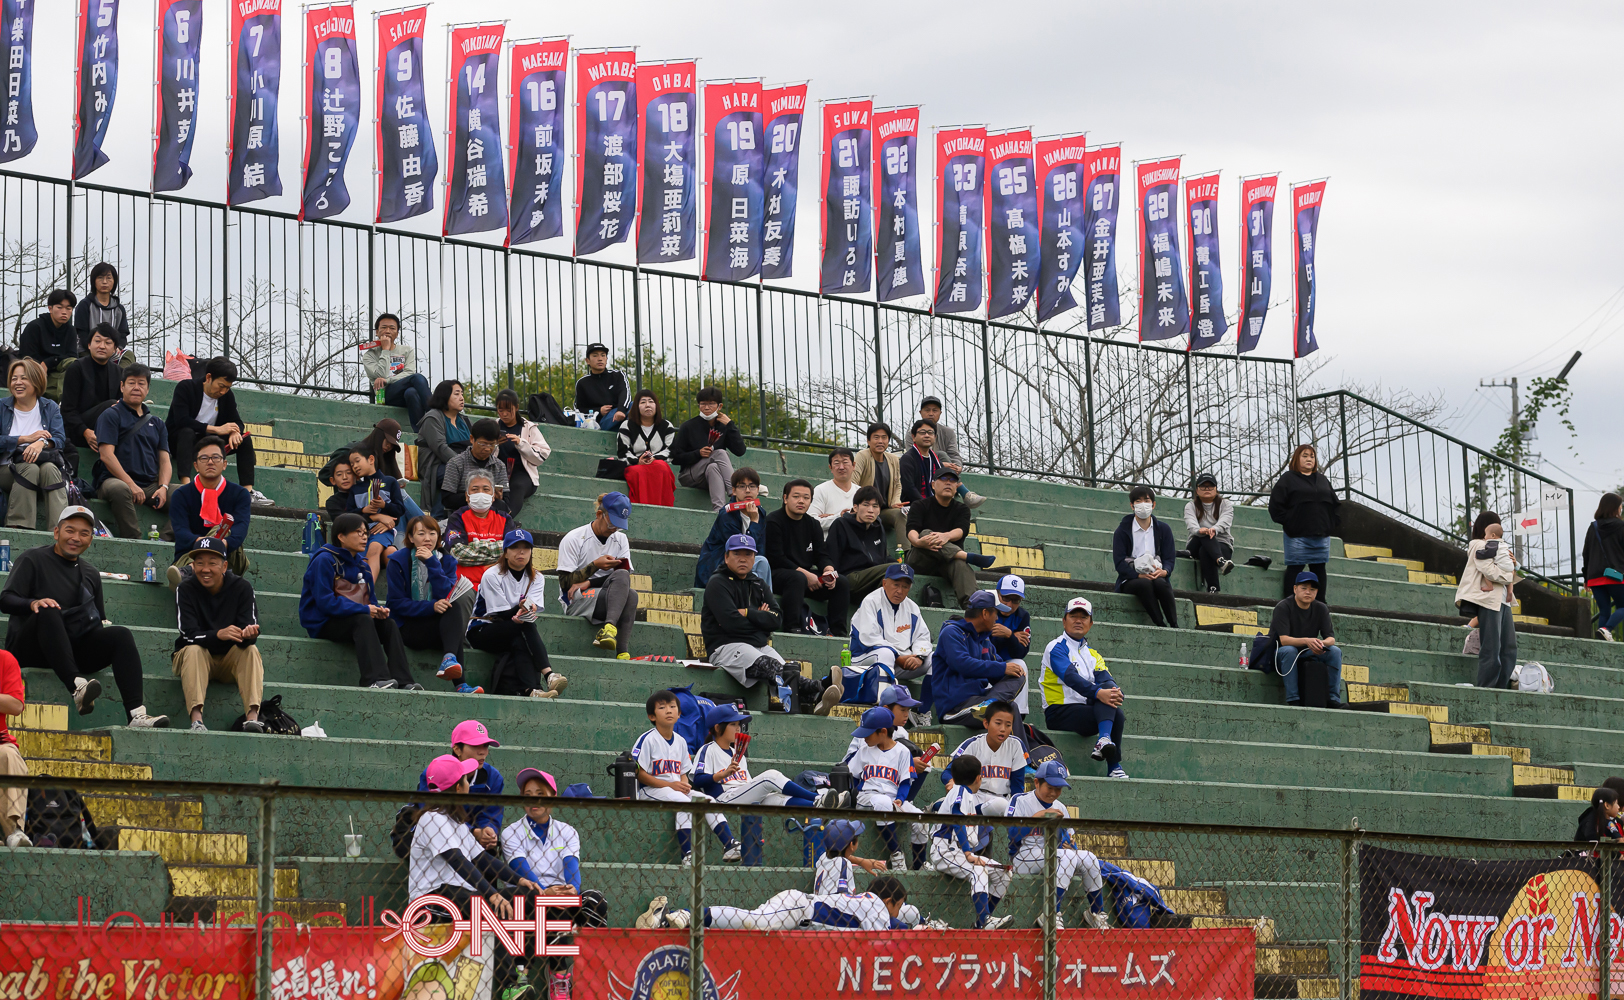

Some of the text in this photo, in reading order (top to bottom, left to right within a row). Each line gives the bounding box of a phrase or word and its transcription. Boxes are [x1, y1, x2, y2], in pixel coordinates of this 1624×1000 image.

[96, 0, 113, 27] 5
[175, 10, 190, 43] 6
[313, 17, 354, 39] TSUJINO
[250, 24, 264, 58] 7
[389, 19, 422, 42] SATOH
[460, 35, 501, 55] YOKOTANI
[324, 47, 342, 79] 8
[396, 50, 413, 82] 9
[521, 51, 565, 72] MAESAKA
[587, 61, 635, 82] WATABE
[3, 17, 24, 153] 柴田日菜乃
[91, 34, 109, 132] 竹内み
[465, 62, 486, 96] 14
[652, 73, 691, 92] OHBA
[526, 80, 557, 112] 16
[595, 90, 626, 122] 17
[721, 92, 758, 111] HARA
[243, 70, 265, 188] 小川原結
[657, 101, 689, 133] 18
[833, 110, 869, 129] SUWA
[878, 117, 916, 140] HOMMURA
[394, 94, 425, 207] 佐藤由香
[726, 120, 756, 151] 19
[771, 122, 799, 154] 20
[943, 136, 985, 157] KIYOHARA
[989, 139, 1032, 161] TAKAHASHI
[466, 107, 489, 217] 横谷瑞希
[838, 137, 860, 168] 21
[886, 144, 909, 175] 22
[1042, 146, 1085, 168] YAMAMOTO
[1090, 156, 1120, 177] KANAI
[529, 123, 554, 229] 前坂未夢
[599, 134, 624, 240] 渡部桜花
[952, 163, 977, 192] 23
[999, 165, 1028, 196] 25
[1052, 171, 1077, 202] 26
[1141, 167, 1179, 189] FUKUSHIMA
[1092, 182, 1115, 212] 27
[1148, 191, 1169, 222] 29
[842, 174, 861, 287] 諏訪いろは
[1192, 207, 1212, 236] 30
[1251, 208, 1265, 237] 31
[1051, 207, 1073, 311] 山本すみ
[1152, 231, 1176, 328] 福嶋未来
[1545, 492, 1563, 501] トイレ
[981, 764, 1012, 780] AKEN
[1377, 886, 1624, 973] Now or Ne
[0, 957, 256, 1000] ab the Victory
[271, 955, 377, 1000] 頑張れ!
